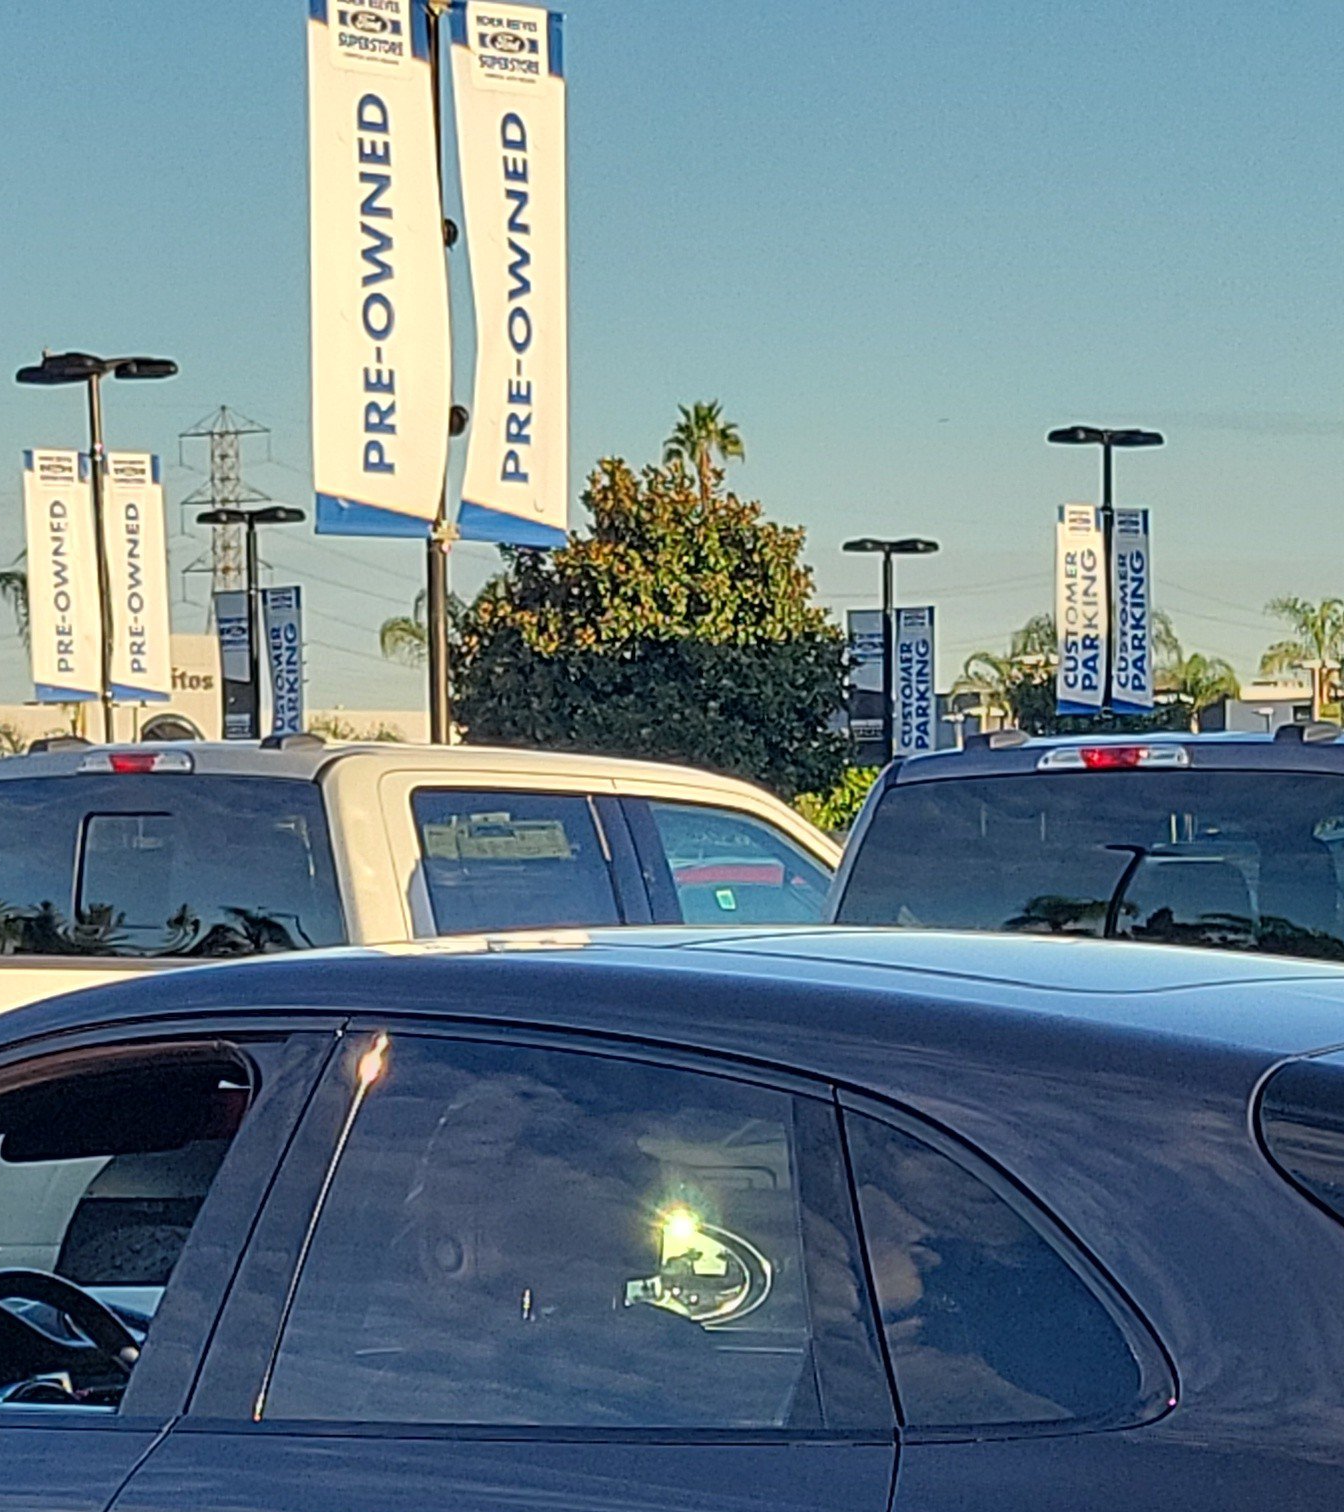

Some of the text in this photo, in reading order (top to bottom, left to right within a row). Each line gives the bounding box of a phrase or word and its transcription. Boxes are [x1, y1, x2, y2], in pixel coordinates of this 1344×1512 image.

[338, 32, 403, 56] SUPERSTORE
[357, 93, 396, 474] PRE-OWNED
[501, 113, 532, 483] PRE-OWNED
[49, 500, 75, 673] PRE-OWNED
[125, 502, 147, 674] PRE-OWNED
[1065, 551, 1078, 689] CUSTOMER
[1081, 548, 1100, 692] PARKING
[1117, 552, 1129, 689] CUSTOMER
[1130, 550, 1146, 692] PARKING
[270, 626, 285, 732] USTOMER
[284, 623, 298, 732] ARKING
[899, 641, 913, 748] CUSTOMER
[915, 638, 930, 750] PARKING
